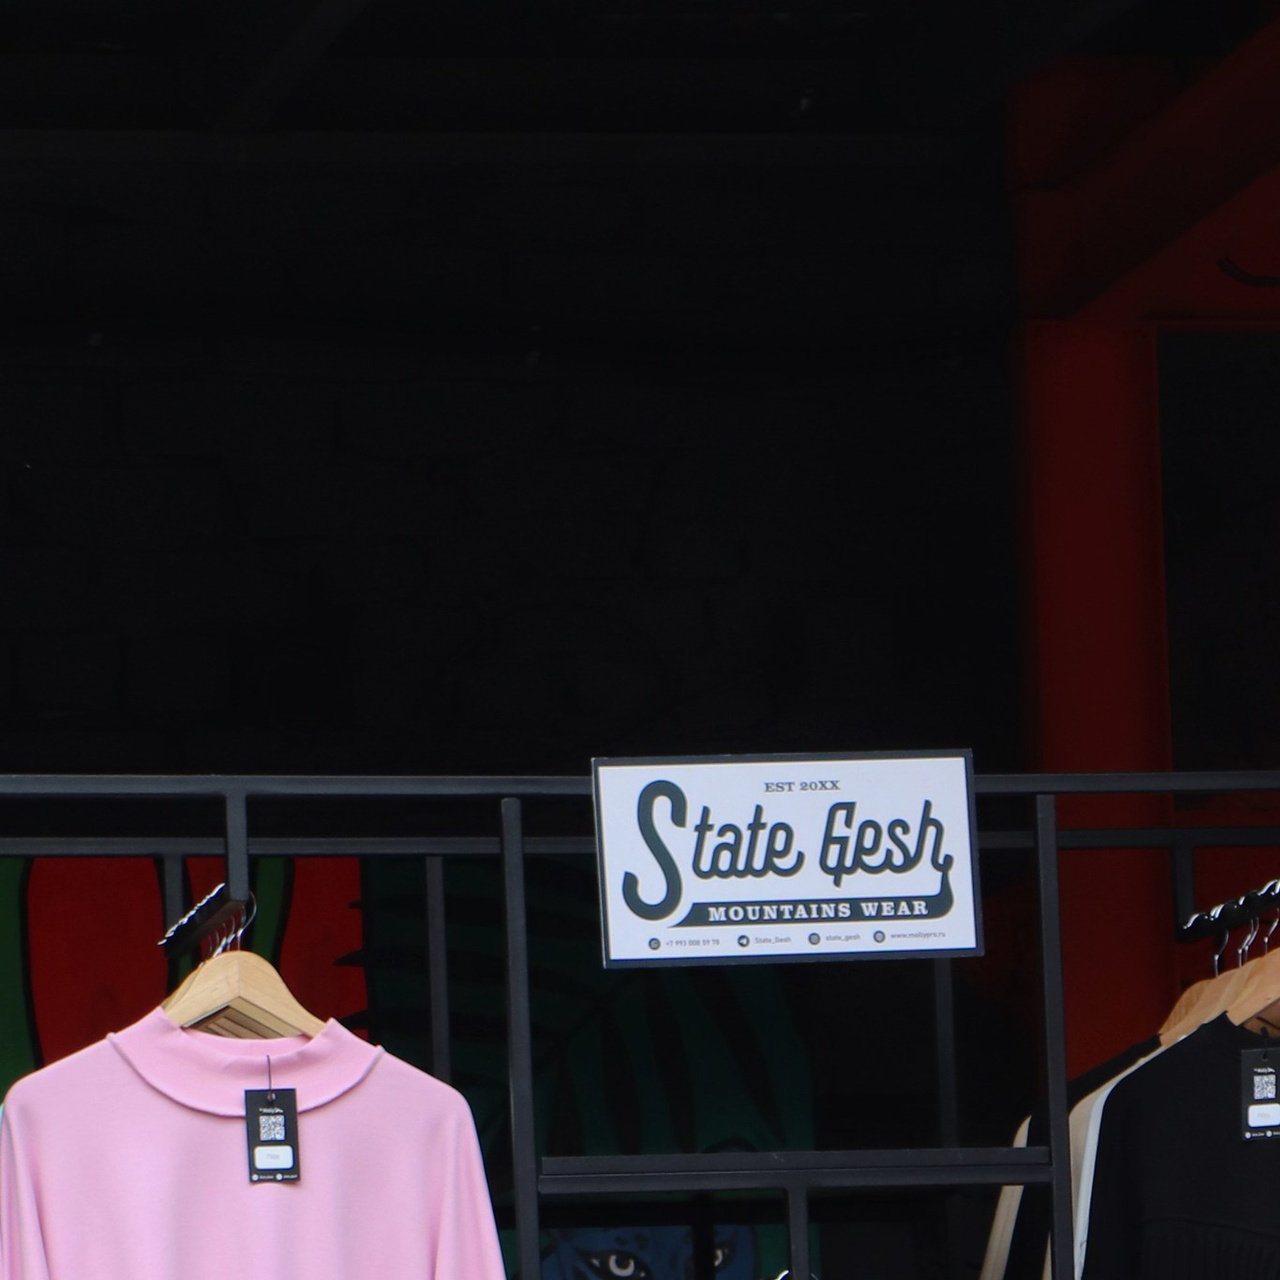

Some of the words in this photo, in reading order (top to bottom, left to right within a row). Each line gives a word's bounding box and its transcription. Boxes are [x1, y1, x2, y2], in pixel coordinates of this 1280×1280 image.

[764, 782, 796, 793] EST
[800, 780, 841, 792] 20XX
[622, 779, 805, 921] State
[819, 800, 954, 888] Gesh
[708, 902, 851, 921] MOUNTAINS
[861, 900, 928, 916] WEAR
